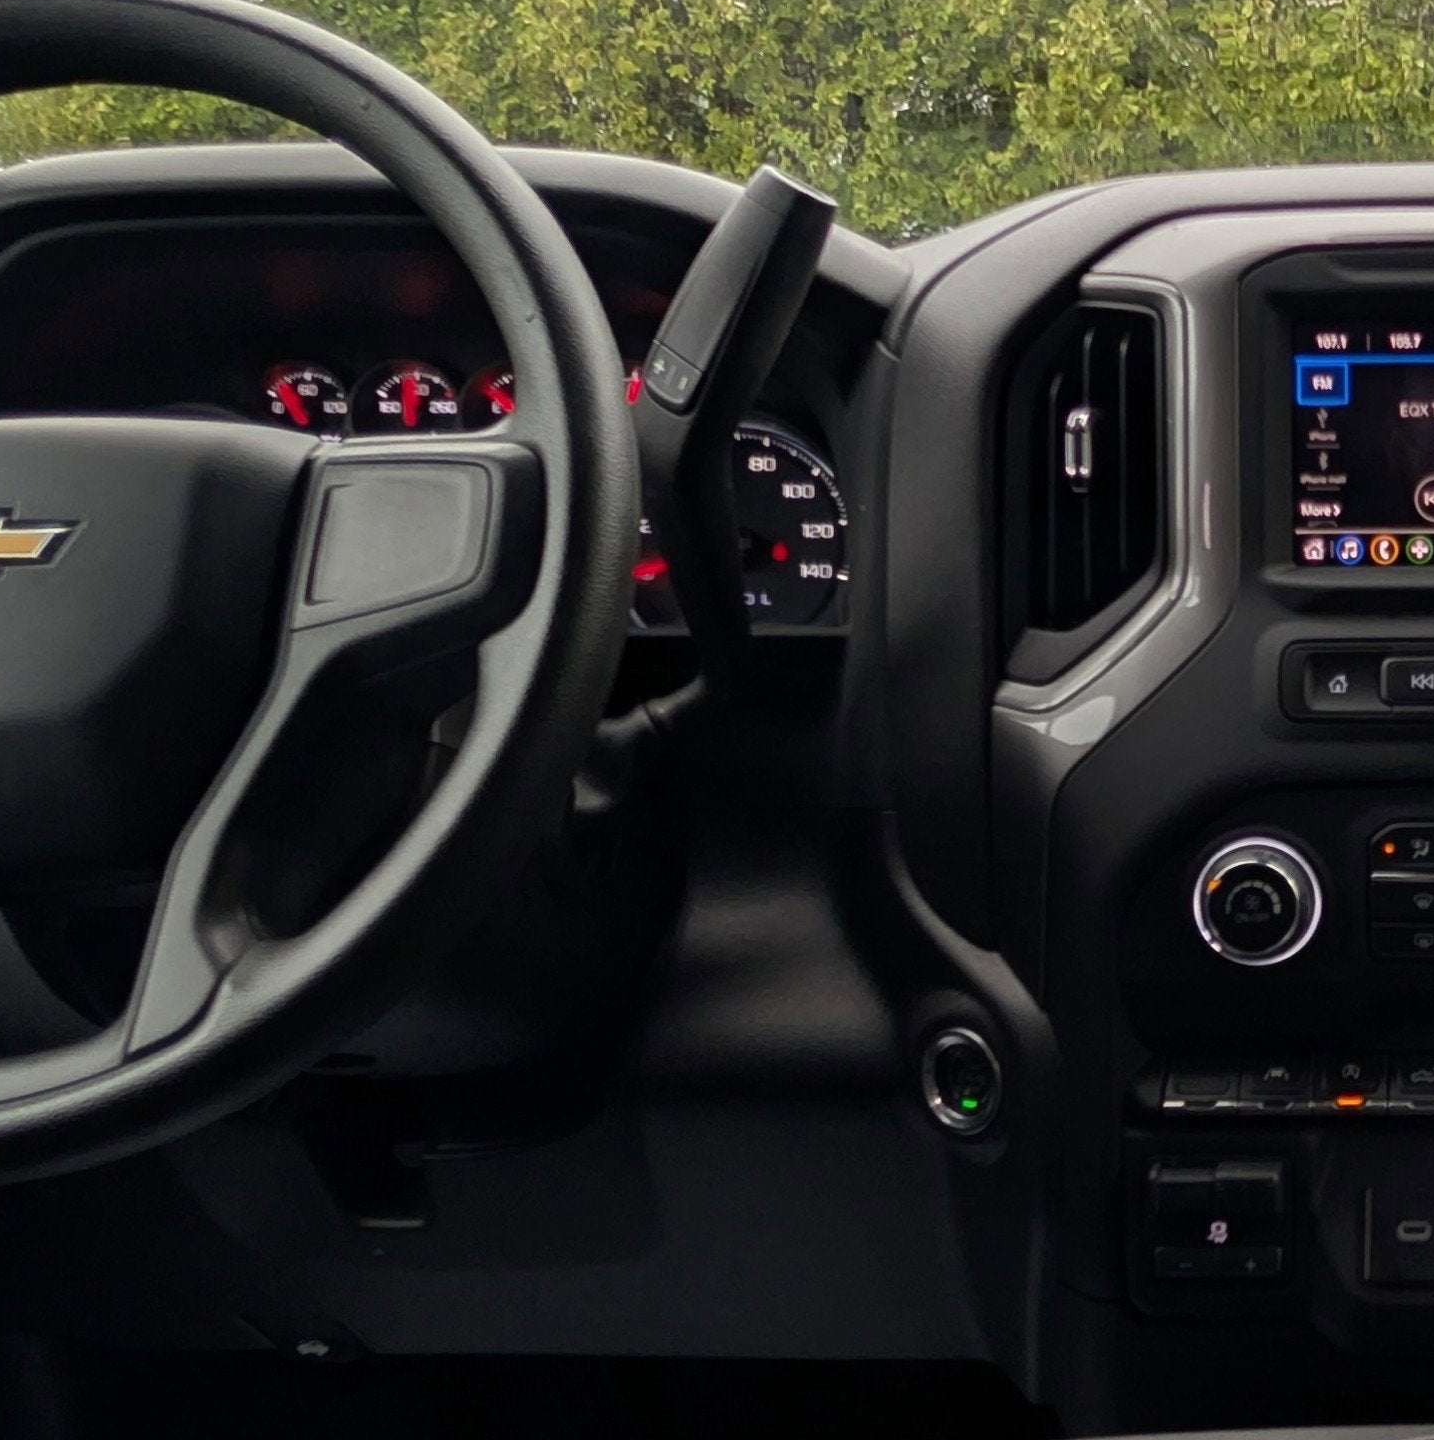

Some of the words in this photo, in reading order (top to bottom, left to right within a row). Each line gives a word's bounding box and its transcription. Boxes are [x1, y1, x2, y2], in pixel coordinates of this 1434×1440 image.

[1399, 402, 1431, 419] EQX
[747, 455, 777, 472] 80
[781, 482, 816, 499] 100
[801, 522, 835, 539] 120
[799, 563, 833, 579] 140
